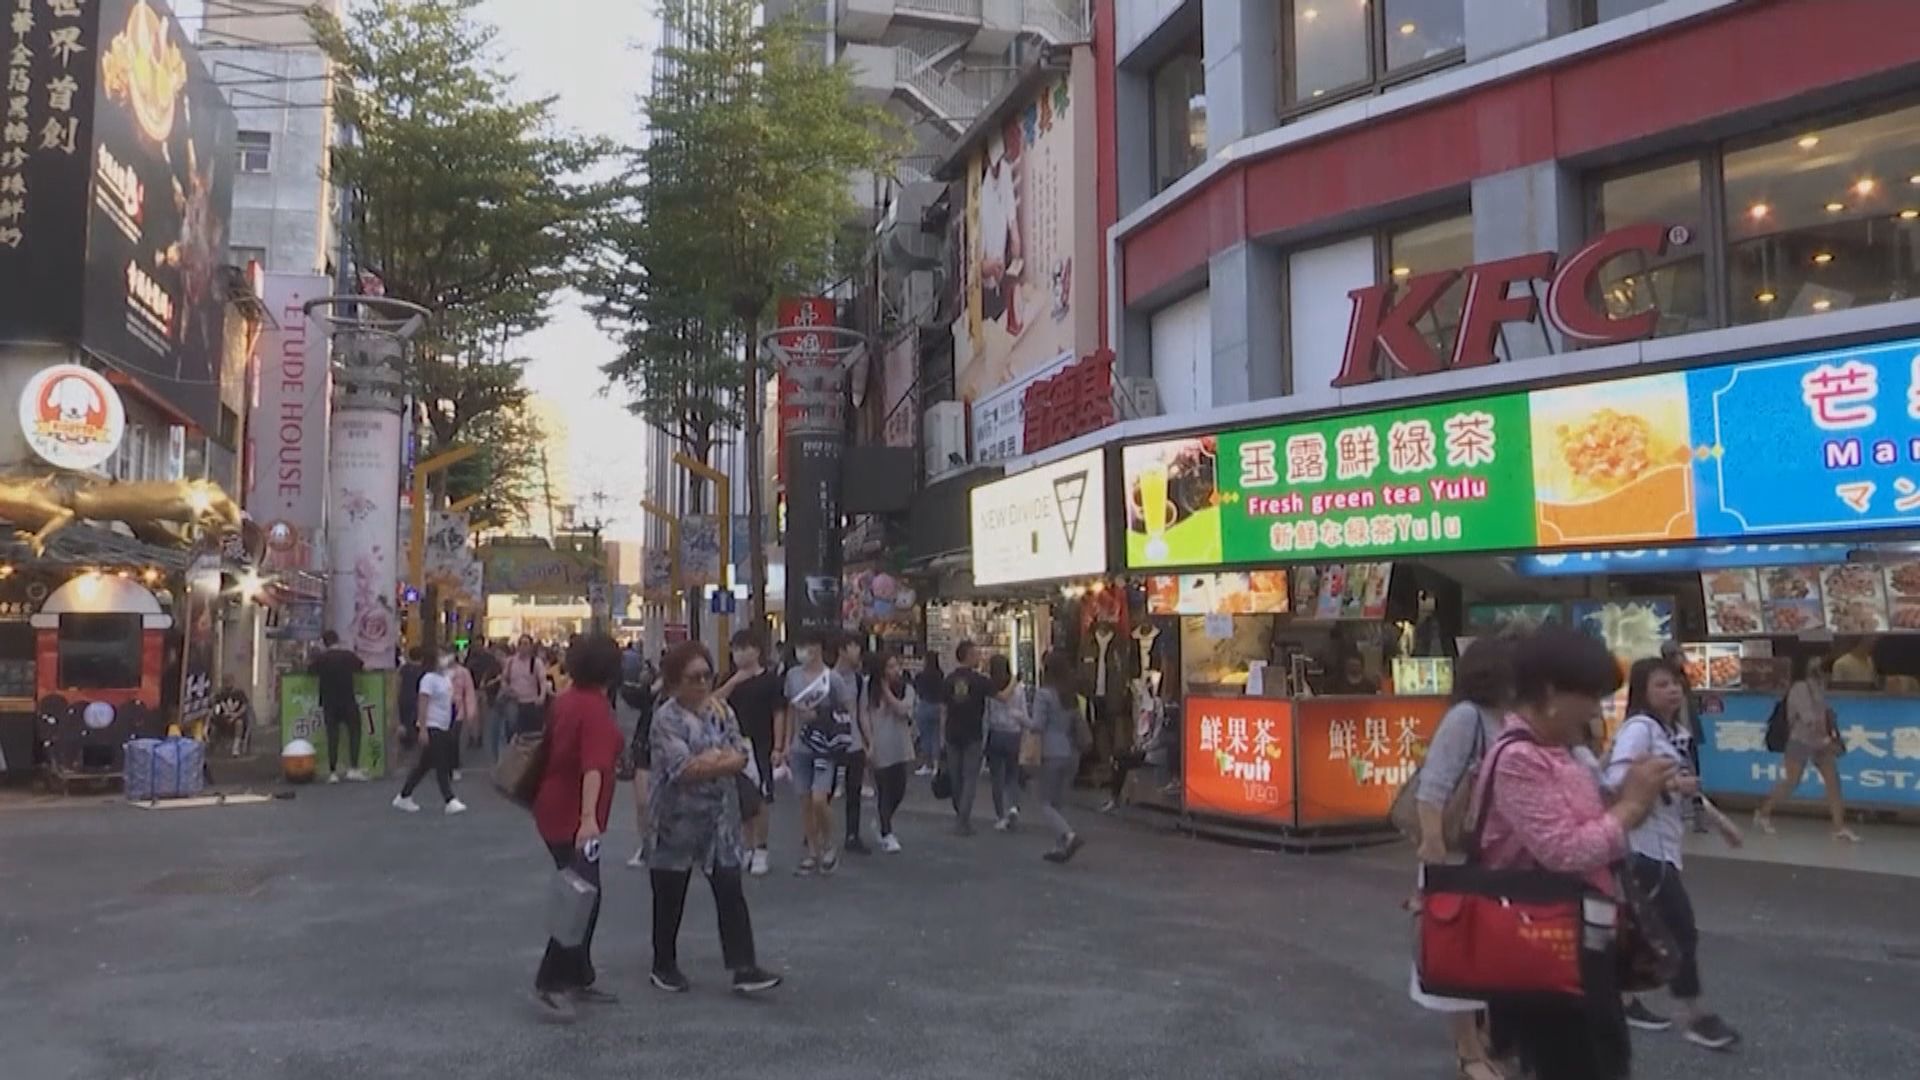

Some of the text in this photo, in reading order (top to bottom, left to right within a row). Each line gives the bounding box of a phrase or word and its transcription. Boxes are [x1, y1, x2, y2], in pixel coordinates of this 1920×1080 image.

[1331, 223, 1668, 386] KFC
[278, 305, 307, 498] ETUDE HOUSE
[1802, 354, 1920, 431] 芒
[1240, 410, 1496, 488] 玉露鮮綠茶
[1248, 476, 1488, 516] Fresh green tea Yulu
[1200, 715, 1280, 757] 鮮果茶
[1328, 717, 1426, 760] 鮮果茶
[1219, 754, 1271, 782] Fruit
